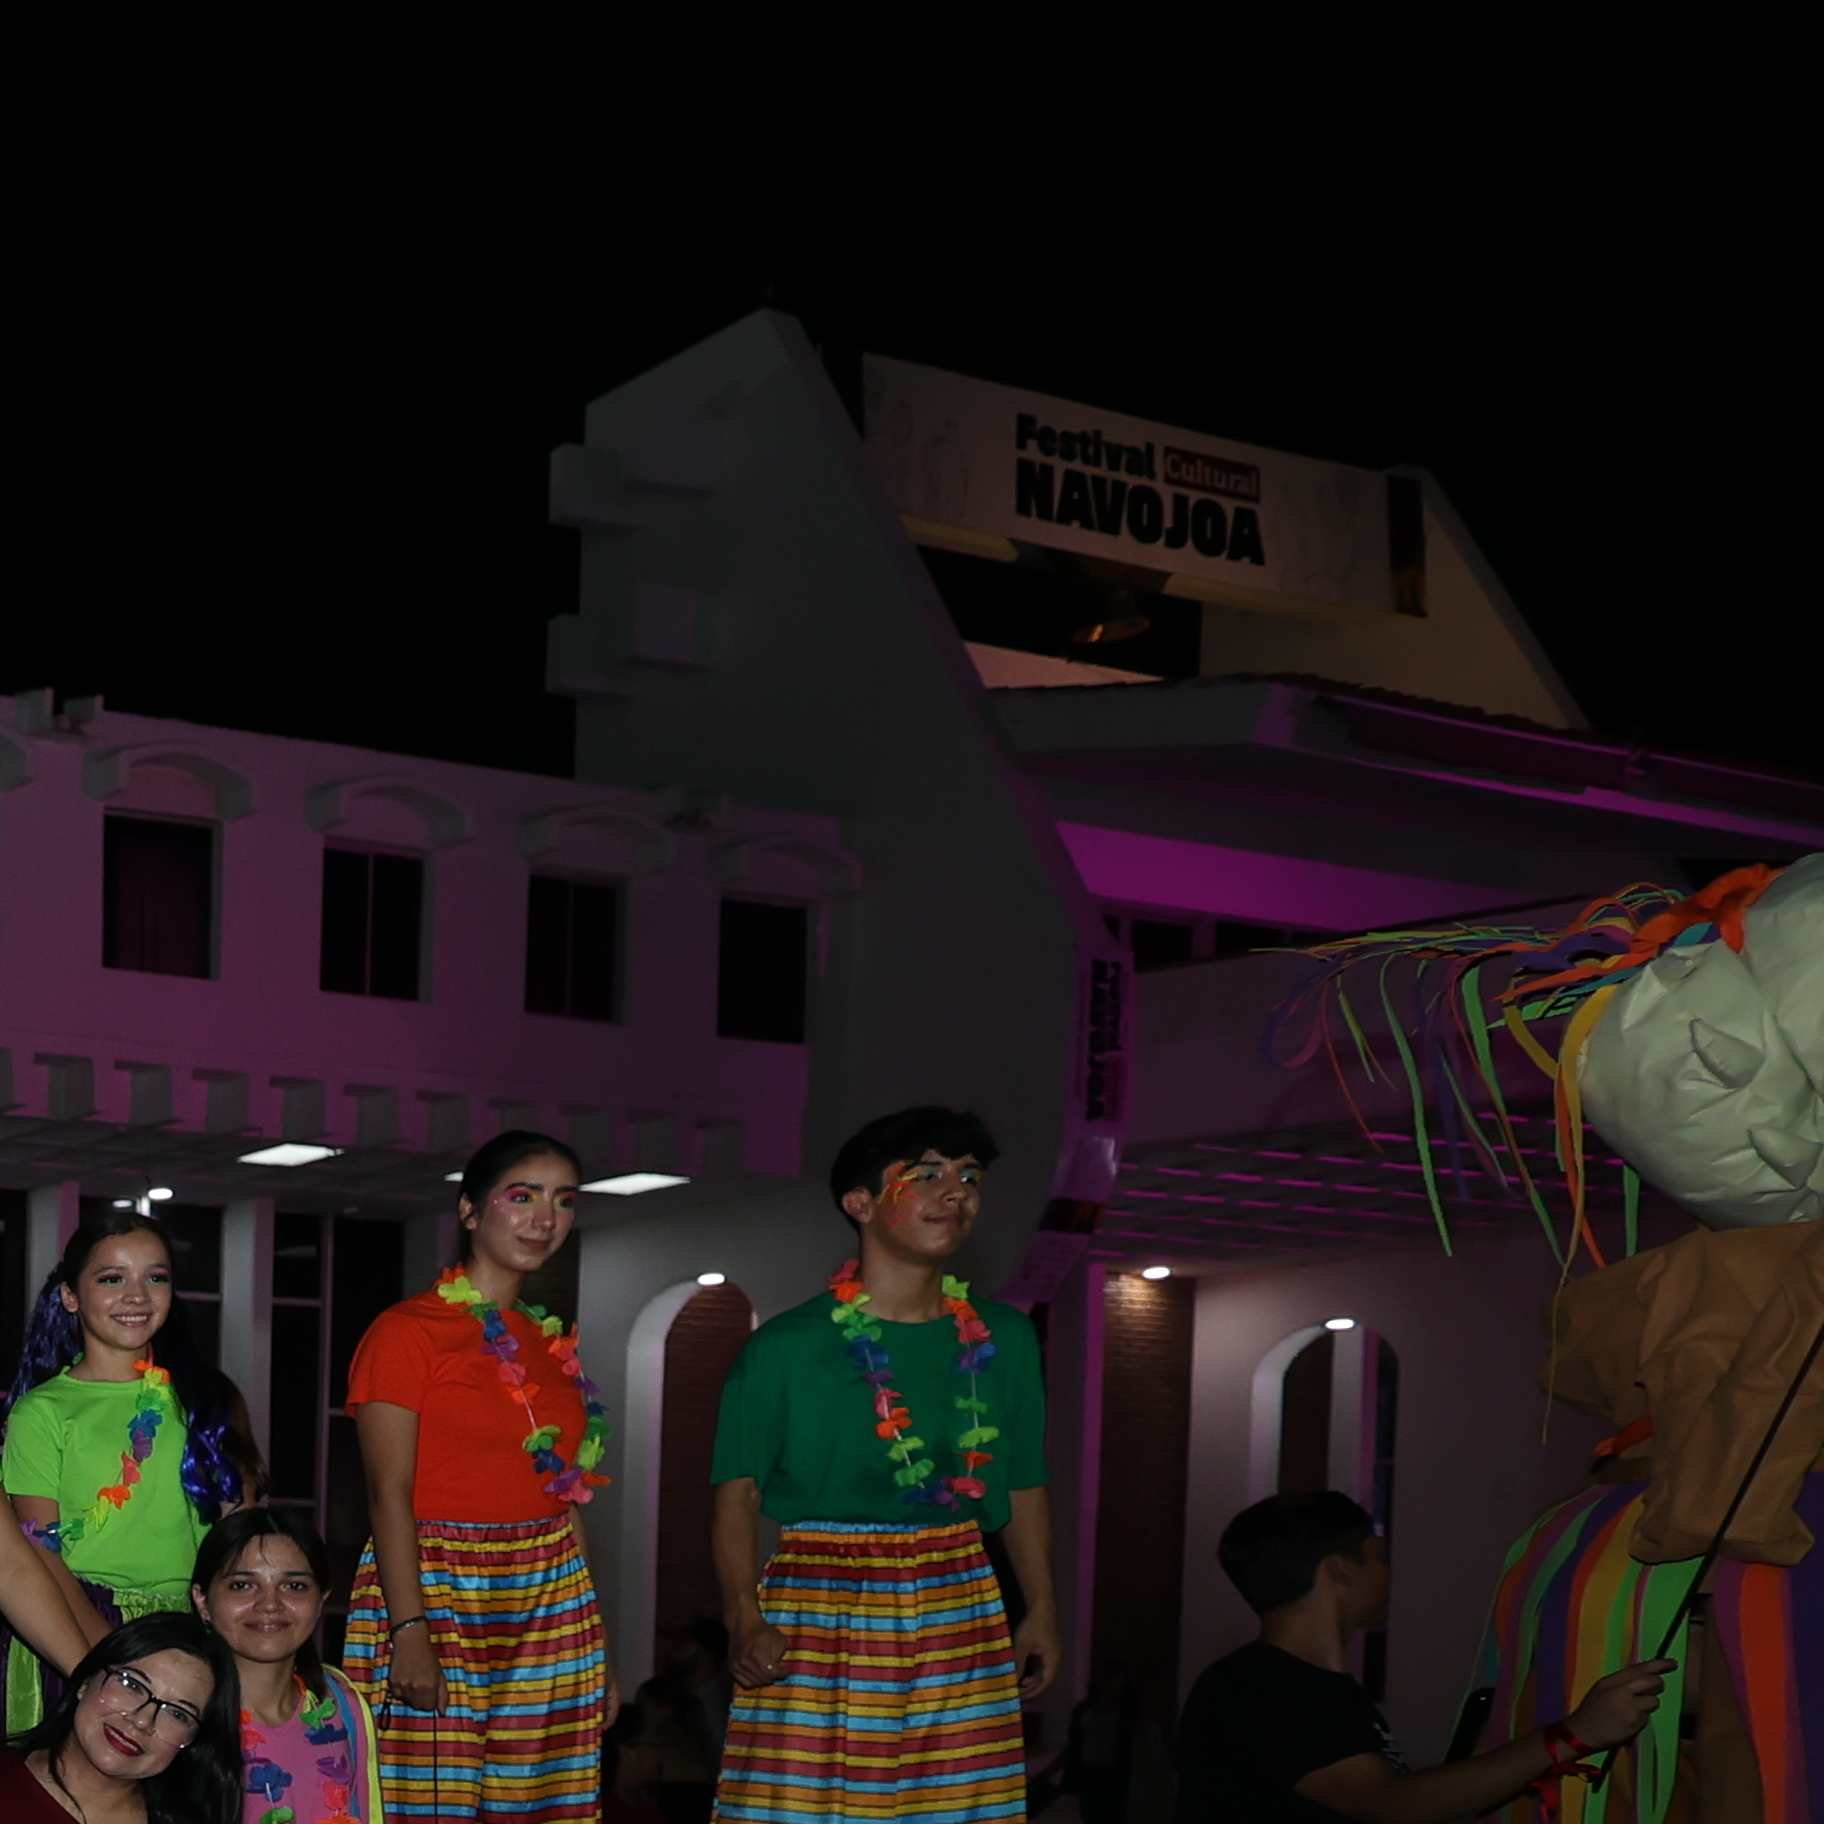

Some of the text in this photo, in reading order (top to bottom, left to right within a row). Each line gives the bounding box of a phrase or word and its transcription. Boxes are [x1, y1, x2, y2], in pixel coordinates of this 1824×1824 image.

[1015, 413, 1259, 496] Festival Cultural
[1016, 458, 1265, 566] NAVOJOA
[1086, 959, 1107, 1120] NAVOJOA
